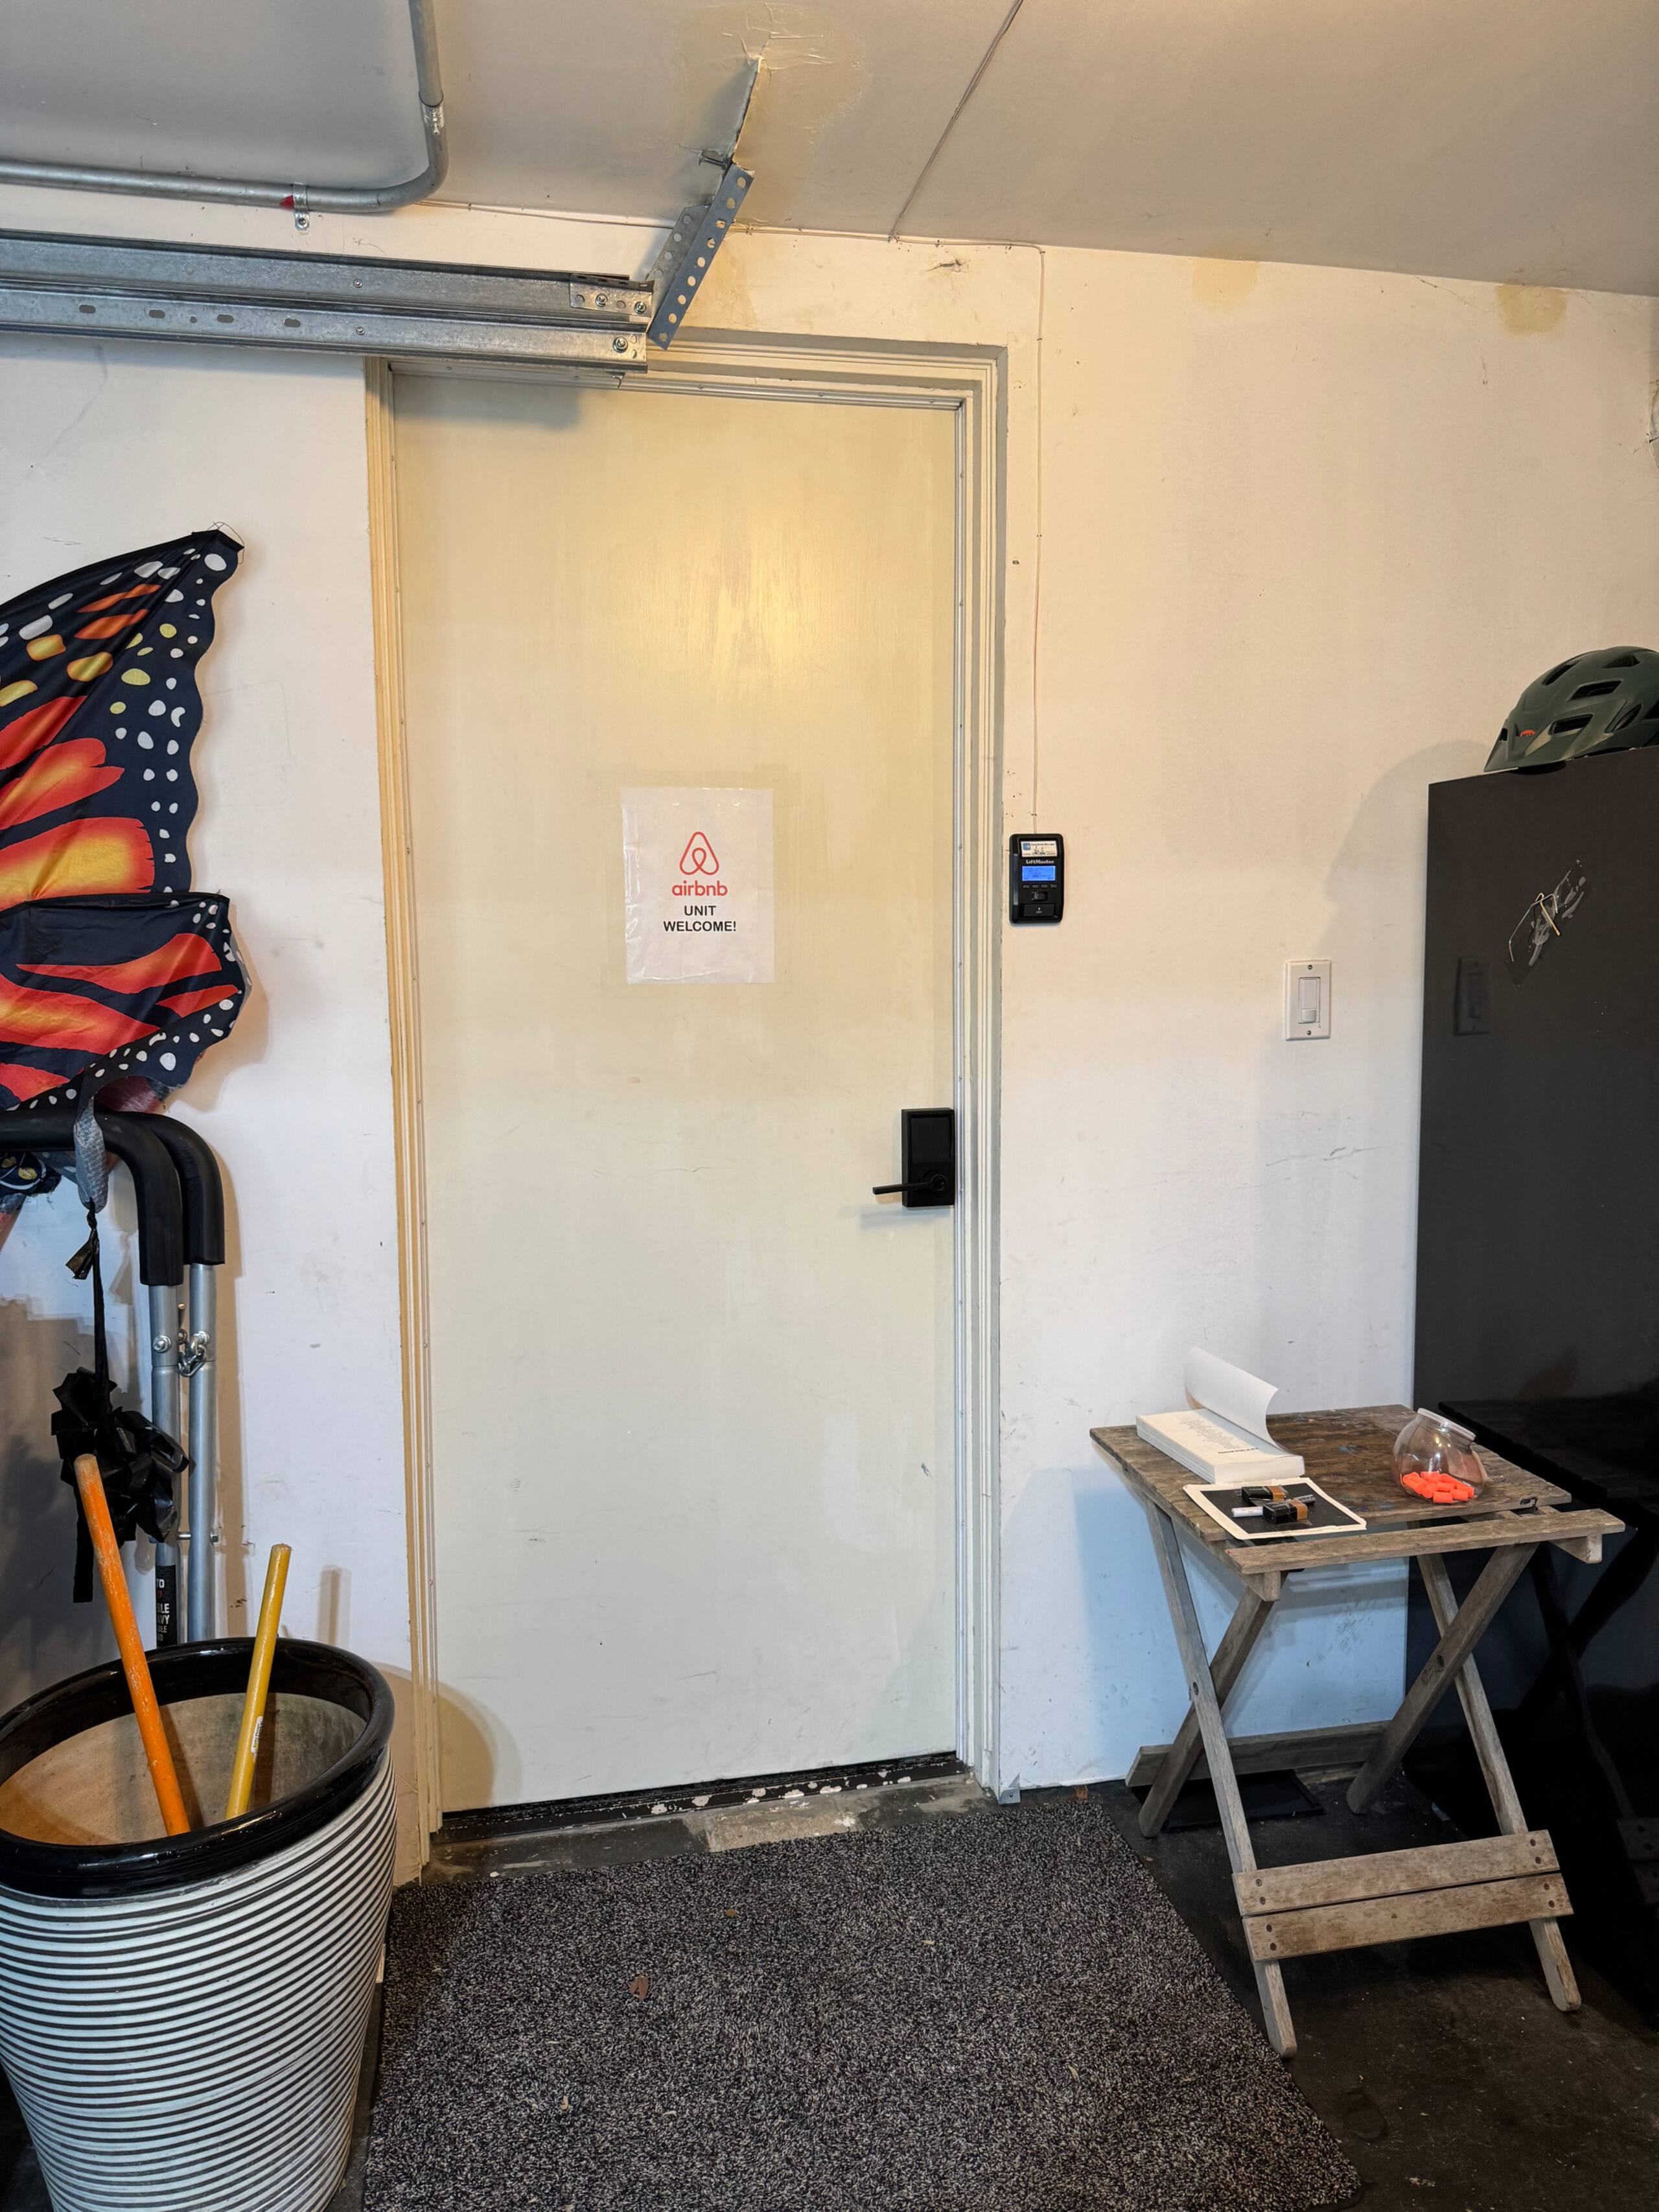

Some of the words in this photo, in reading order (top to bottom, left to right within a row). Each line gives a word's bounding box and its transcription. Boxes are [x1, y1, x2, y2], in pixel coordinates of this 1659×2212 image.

[671, 880, 728, 896] airbnb
[684, 905, 716, 916] UNIT
[664, 921, 736, 931] WELCOME!
